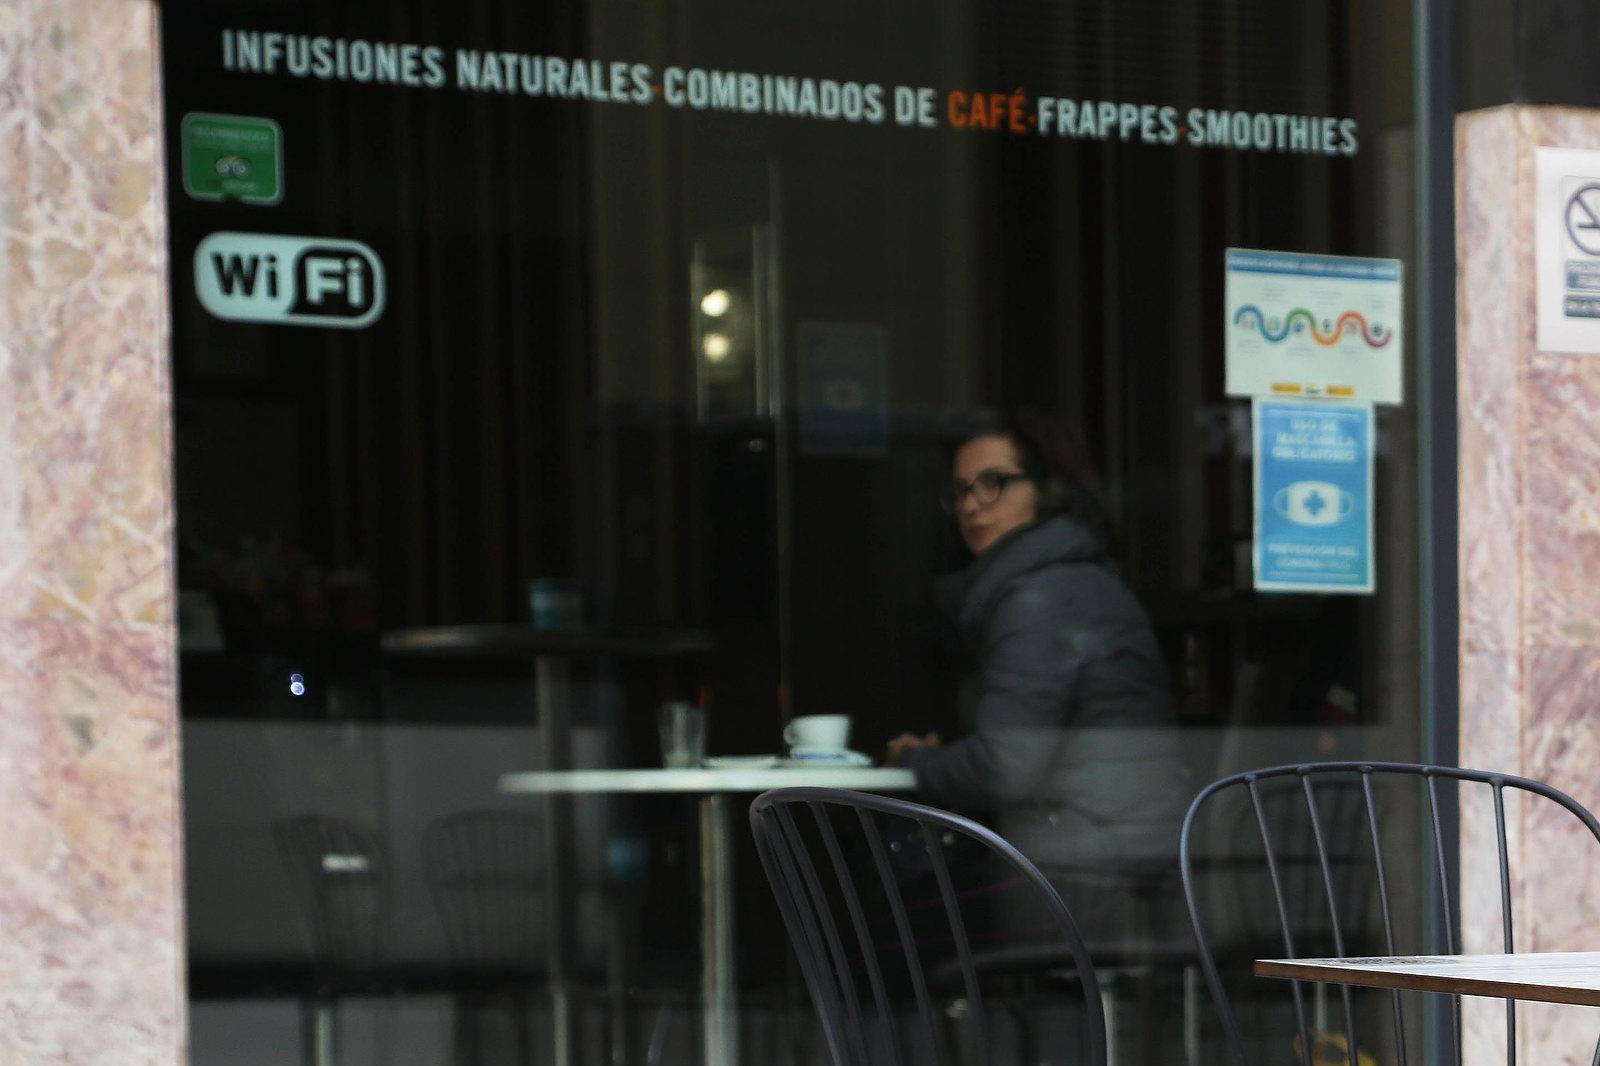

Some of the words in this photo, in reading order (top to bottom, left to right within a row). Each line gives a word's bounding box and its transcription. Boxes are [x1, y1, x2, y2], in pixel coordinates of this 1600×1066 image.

[222, 29, 445, 87] INFUSIONES
[456, 49, 653, 104] NATURALES
[664, 67, 885, 123] COMBINADOS
[895, 86, 936, 127] DE
[948, 88, 1028, 133] CAFÉ
[1038, 97, 1179, 144] FRAPPES
[1187, 108, 1358, 156] SMOOTHIES
